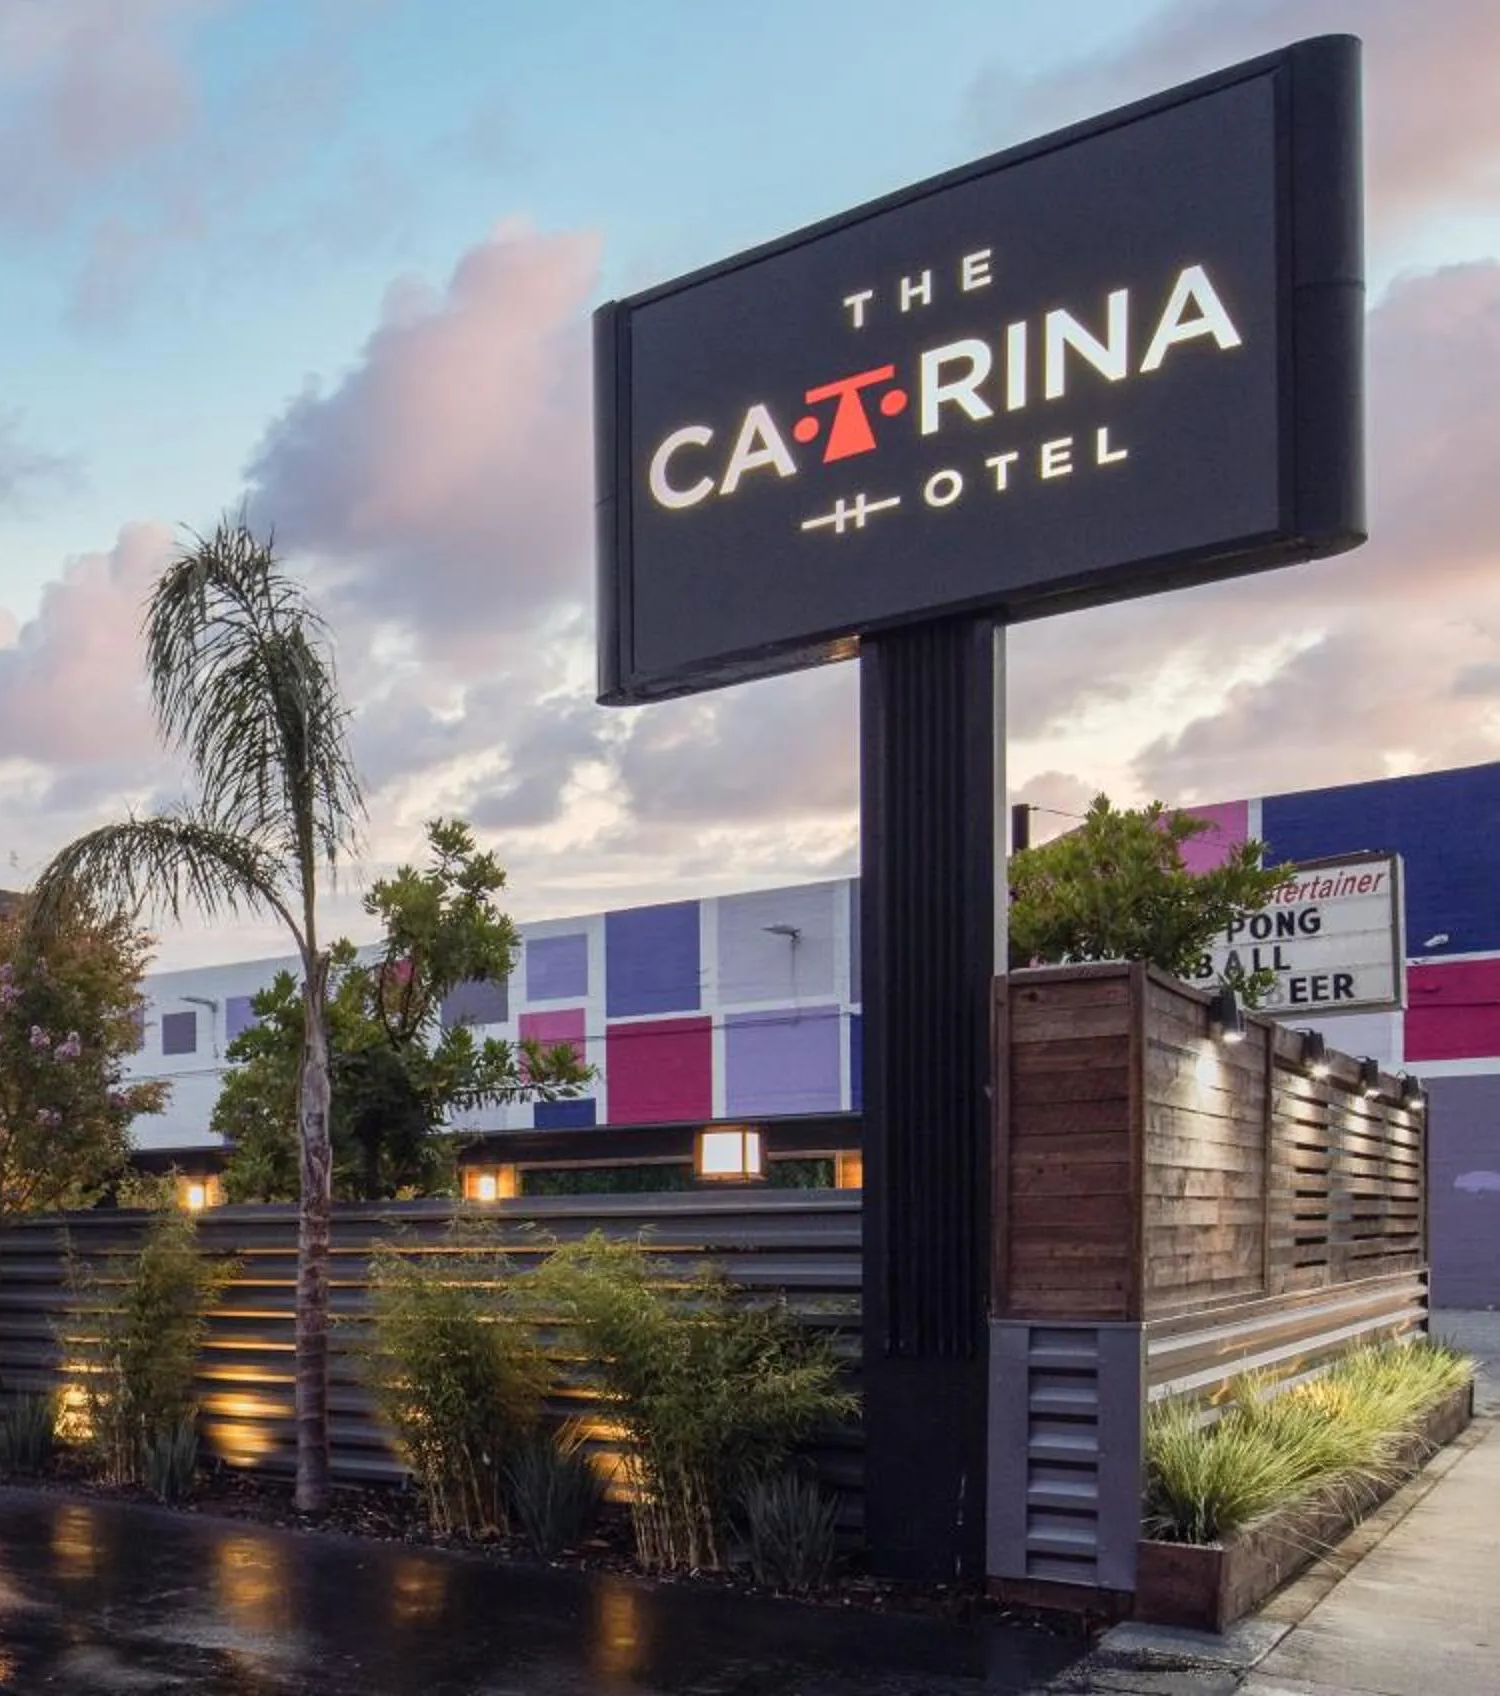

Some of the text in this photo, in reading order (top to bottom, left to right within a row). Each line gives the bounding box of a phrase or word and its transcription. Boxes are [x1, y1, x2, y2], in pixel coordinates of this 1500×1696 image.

[843, 248, 993, 329] THE
[648, 264, 1244, 511] CATRINA
[801, 426, 1130, 534] HOTEL
[1226, 907, 1322, 943] PONG
[1265, 870, 1386, 905] tertainer
